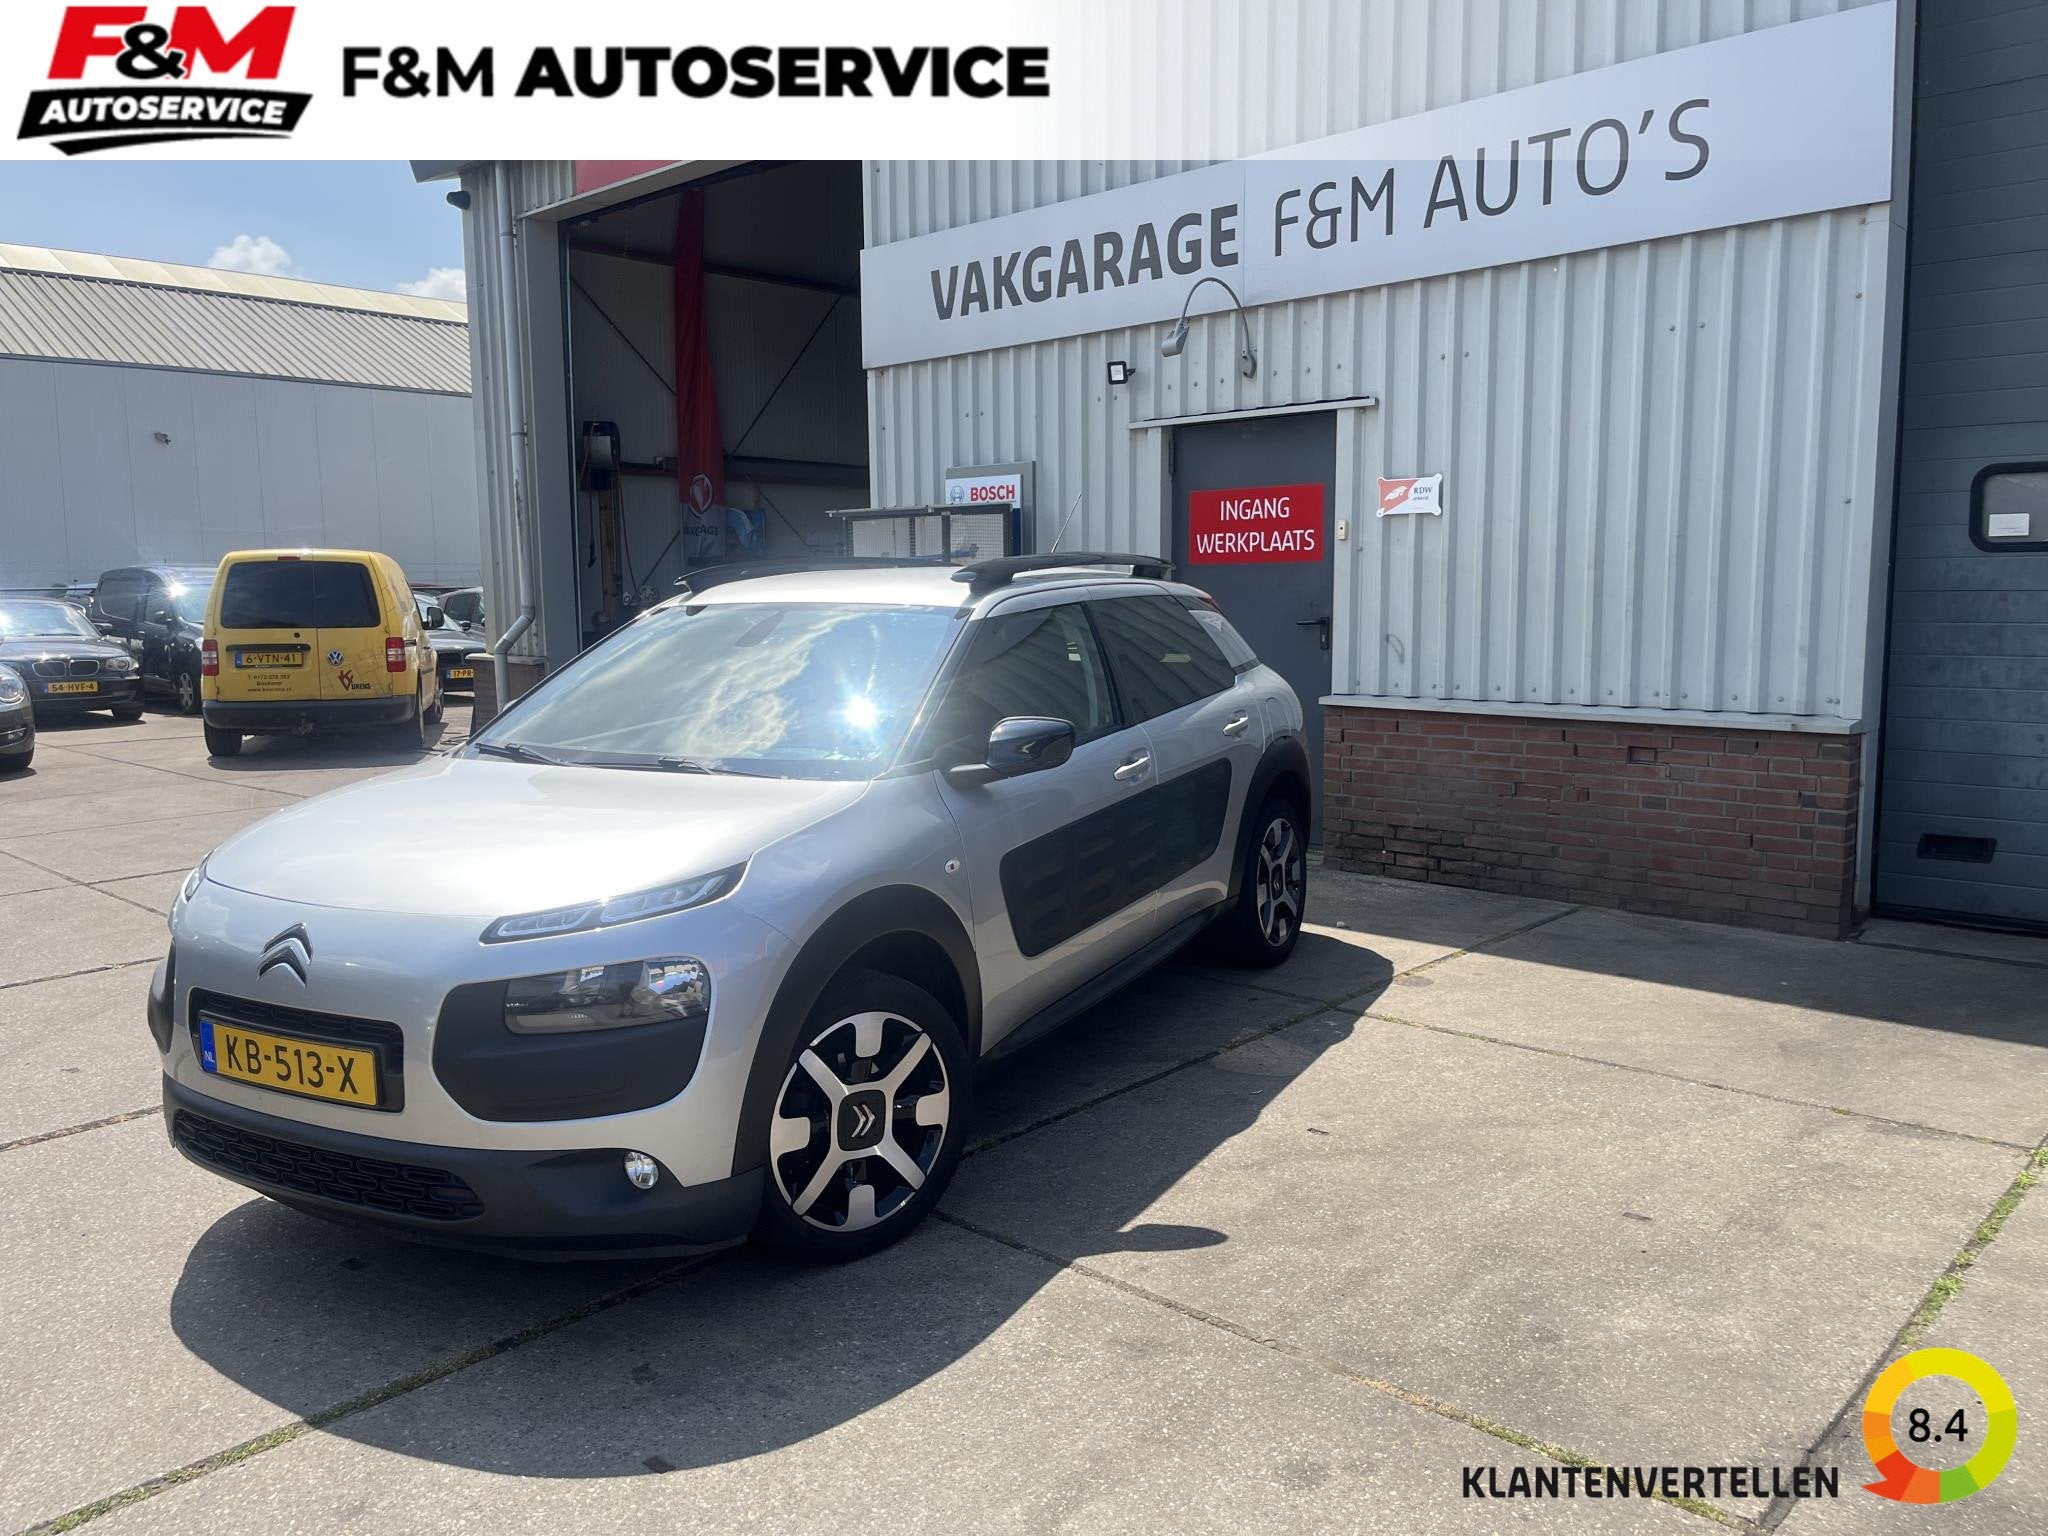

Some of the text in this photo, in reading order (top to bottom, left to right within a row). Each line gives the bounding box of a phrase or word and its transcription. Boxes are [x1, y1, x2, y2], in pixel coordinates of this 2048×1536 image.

[930, 98, 1710, 320] VAKGARAGE F&M AUTO'S
[970, 484, 1015, 501] BOSCH
[1413, 486, 1433, 494] RDW
[1220, 497, 1290, 521] INGANG
[1196, 529, 1315, 554] WERKPLAATS
[246, 653, 297, 664] 6-VTN-41
[452, 669, 474, 677] 17-PR-
[52, 683, 95, 692] 54-HVF-4
[225, 1033, 359, 1095] KB-513-X
